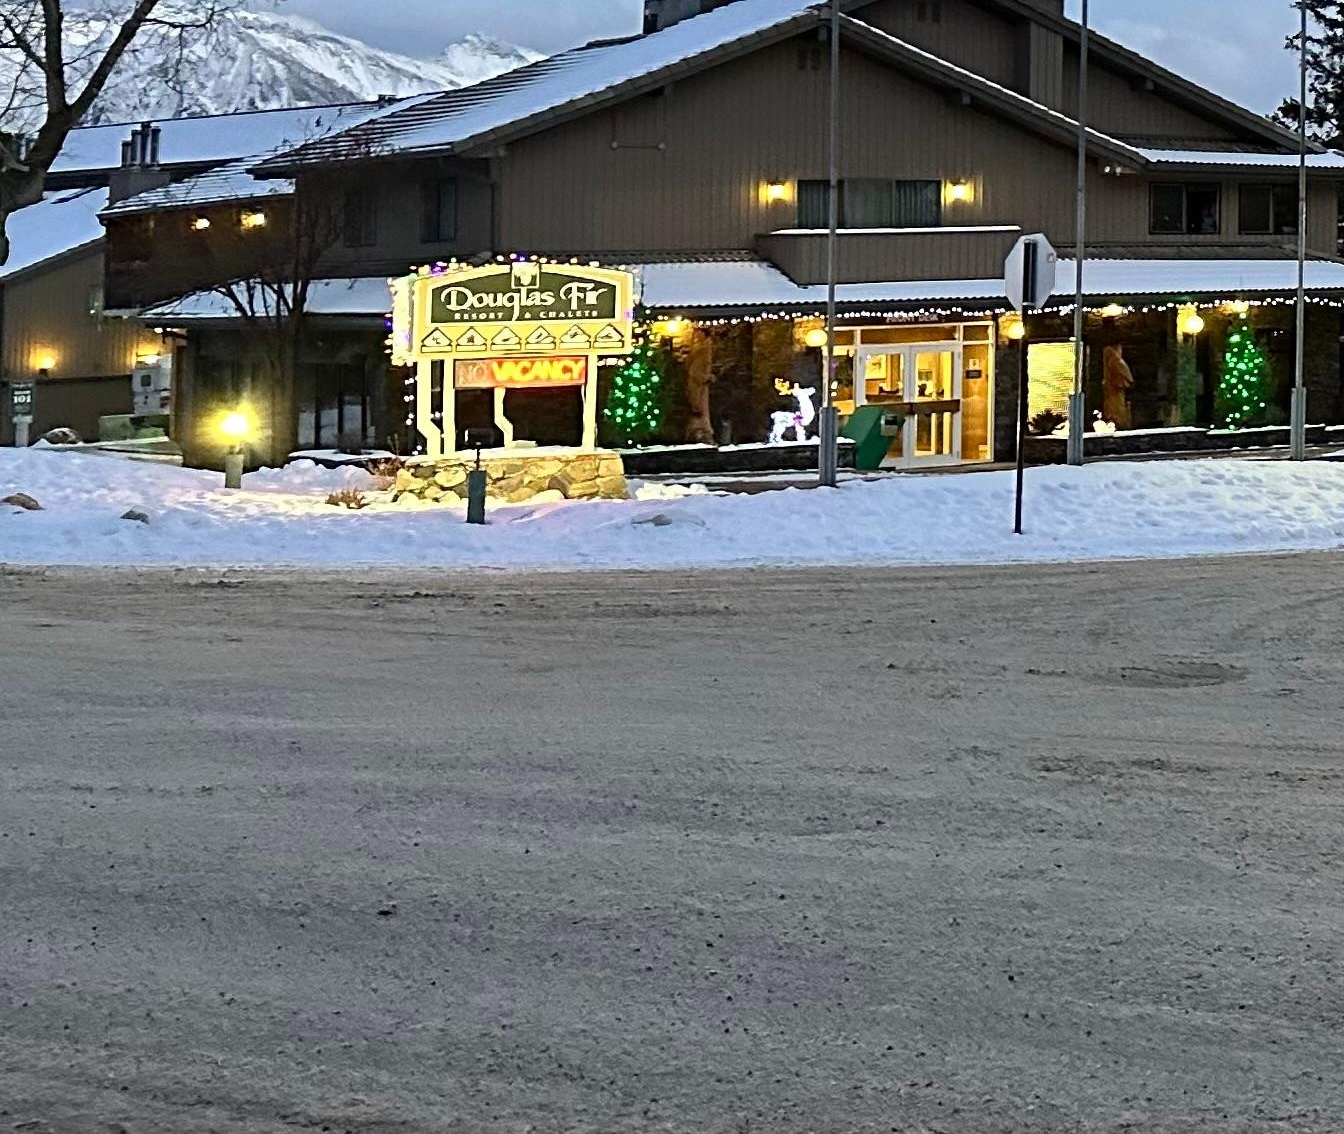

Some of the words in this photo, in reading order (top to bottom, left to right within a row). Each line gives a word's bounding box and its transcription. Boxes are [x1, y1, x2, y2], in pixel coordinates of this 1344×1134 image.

[440, 285, 555, 322] Douglas
[454, 311, 504, 320] RESORT
[539, 310, 599, 319] CHALETS
[457, 360, 489, 385] NO
[491, 359, 585, 381] VACANCY
[13, 394, 31, 403] 101
